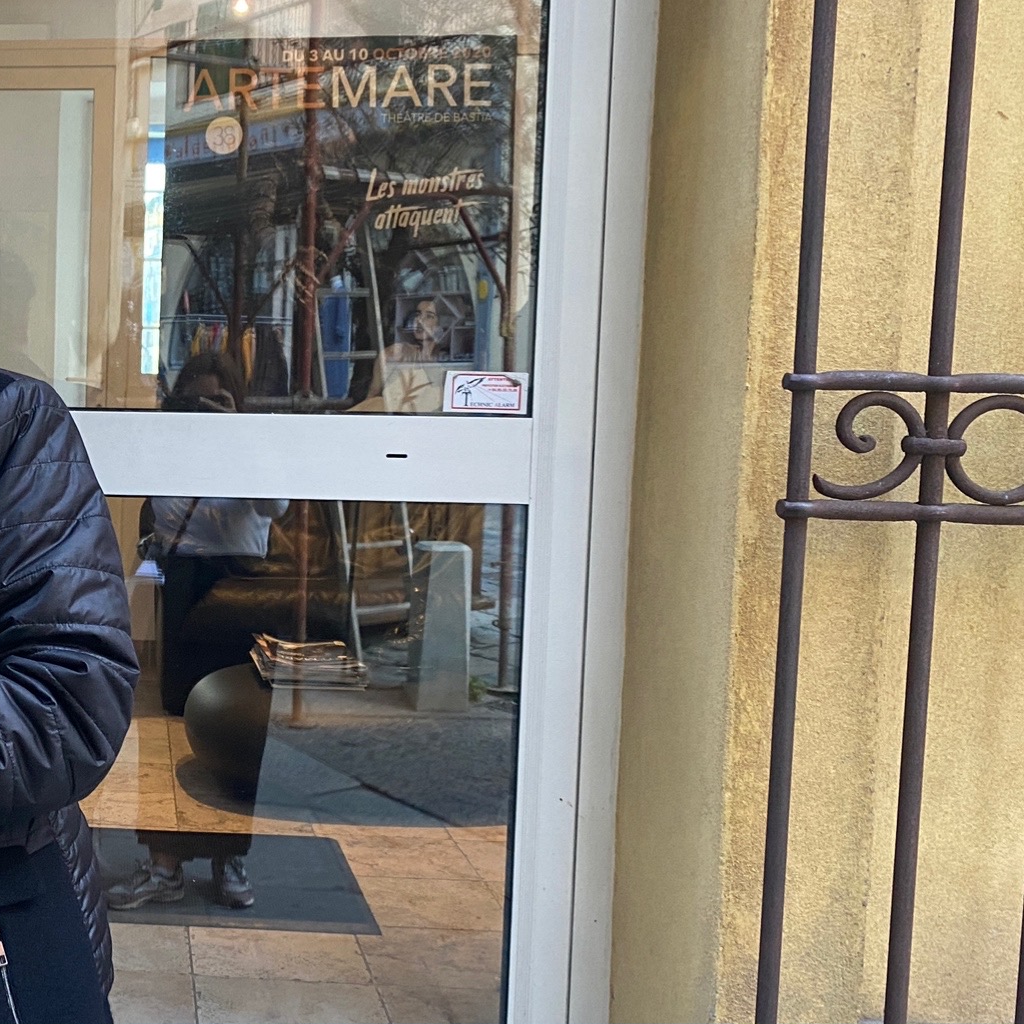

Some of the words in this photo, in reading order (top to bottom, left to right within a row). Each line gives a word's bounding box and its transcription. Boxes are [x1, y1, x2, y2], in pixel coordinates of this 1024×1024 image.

[282, 48, 305, 62] DU
[308, 49, 319, 62] 3
[322, 48, 345, 62] AU
[349, 48, 368, 61] 10
[183, 61, 493, 113] ARTEMARE
[434, 111, 451, 123] DE
[453, 111, 492, 123] BASTIA
[212, 126, 236, 147] 38
[365, 167, 397, 202] Les
[402, 166, 485, 196] monstres
[373, 198, 485, 238] attaquent
